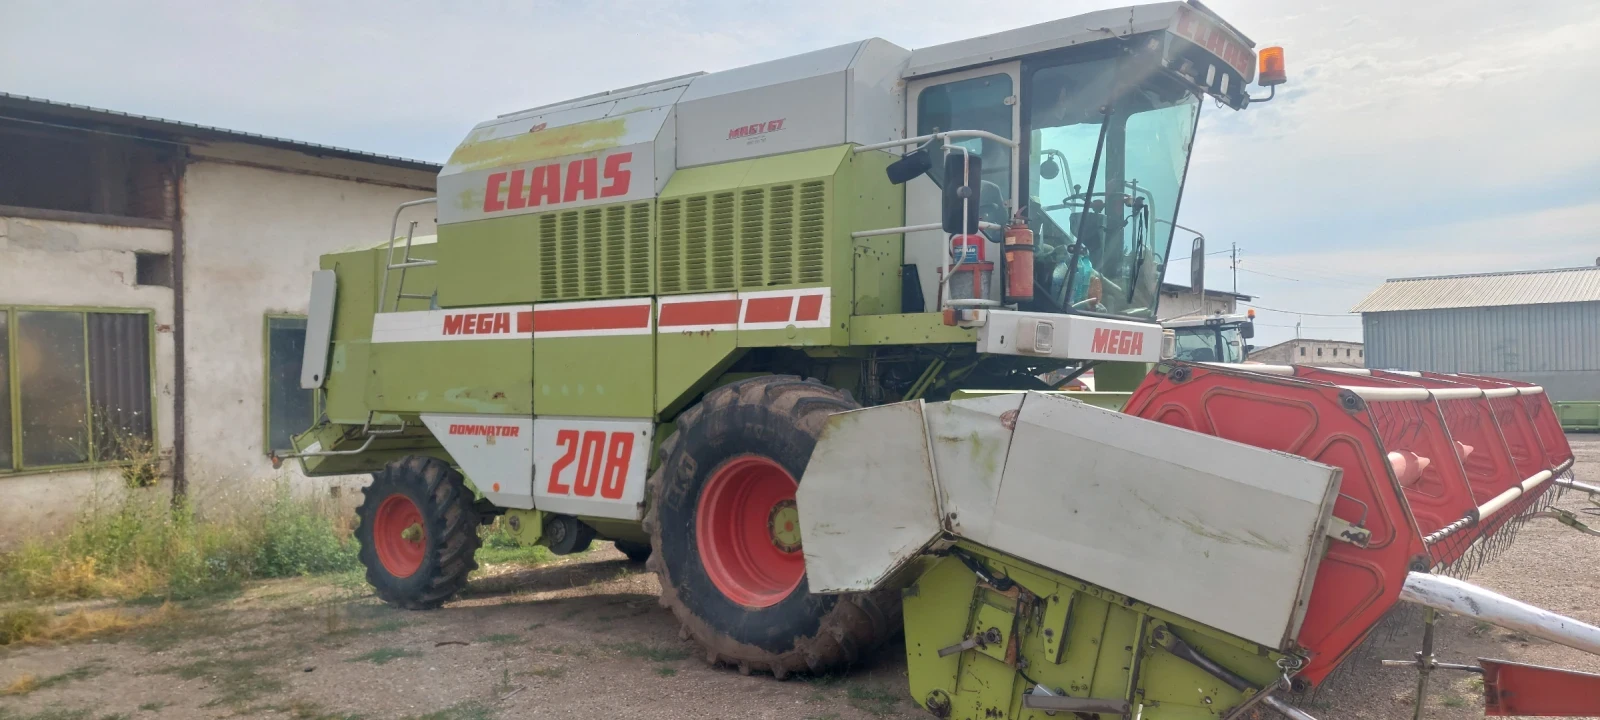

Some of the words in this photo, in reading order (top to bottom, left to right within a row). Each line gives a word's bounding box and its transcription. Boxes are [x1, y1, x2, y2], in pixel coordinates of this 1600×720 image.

[483, 152, 633, 213] CLAAS
[443, 311, 511, 336] MEGA
[1091, 327, 1144, 355] MEGA
[449, 424, 520, 437] DOMINATOR
[547, 429, 635, 500] 208
